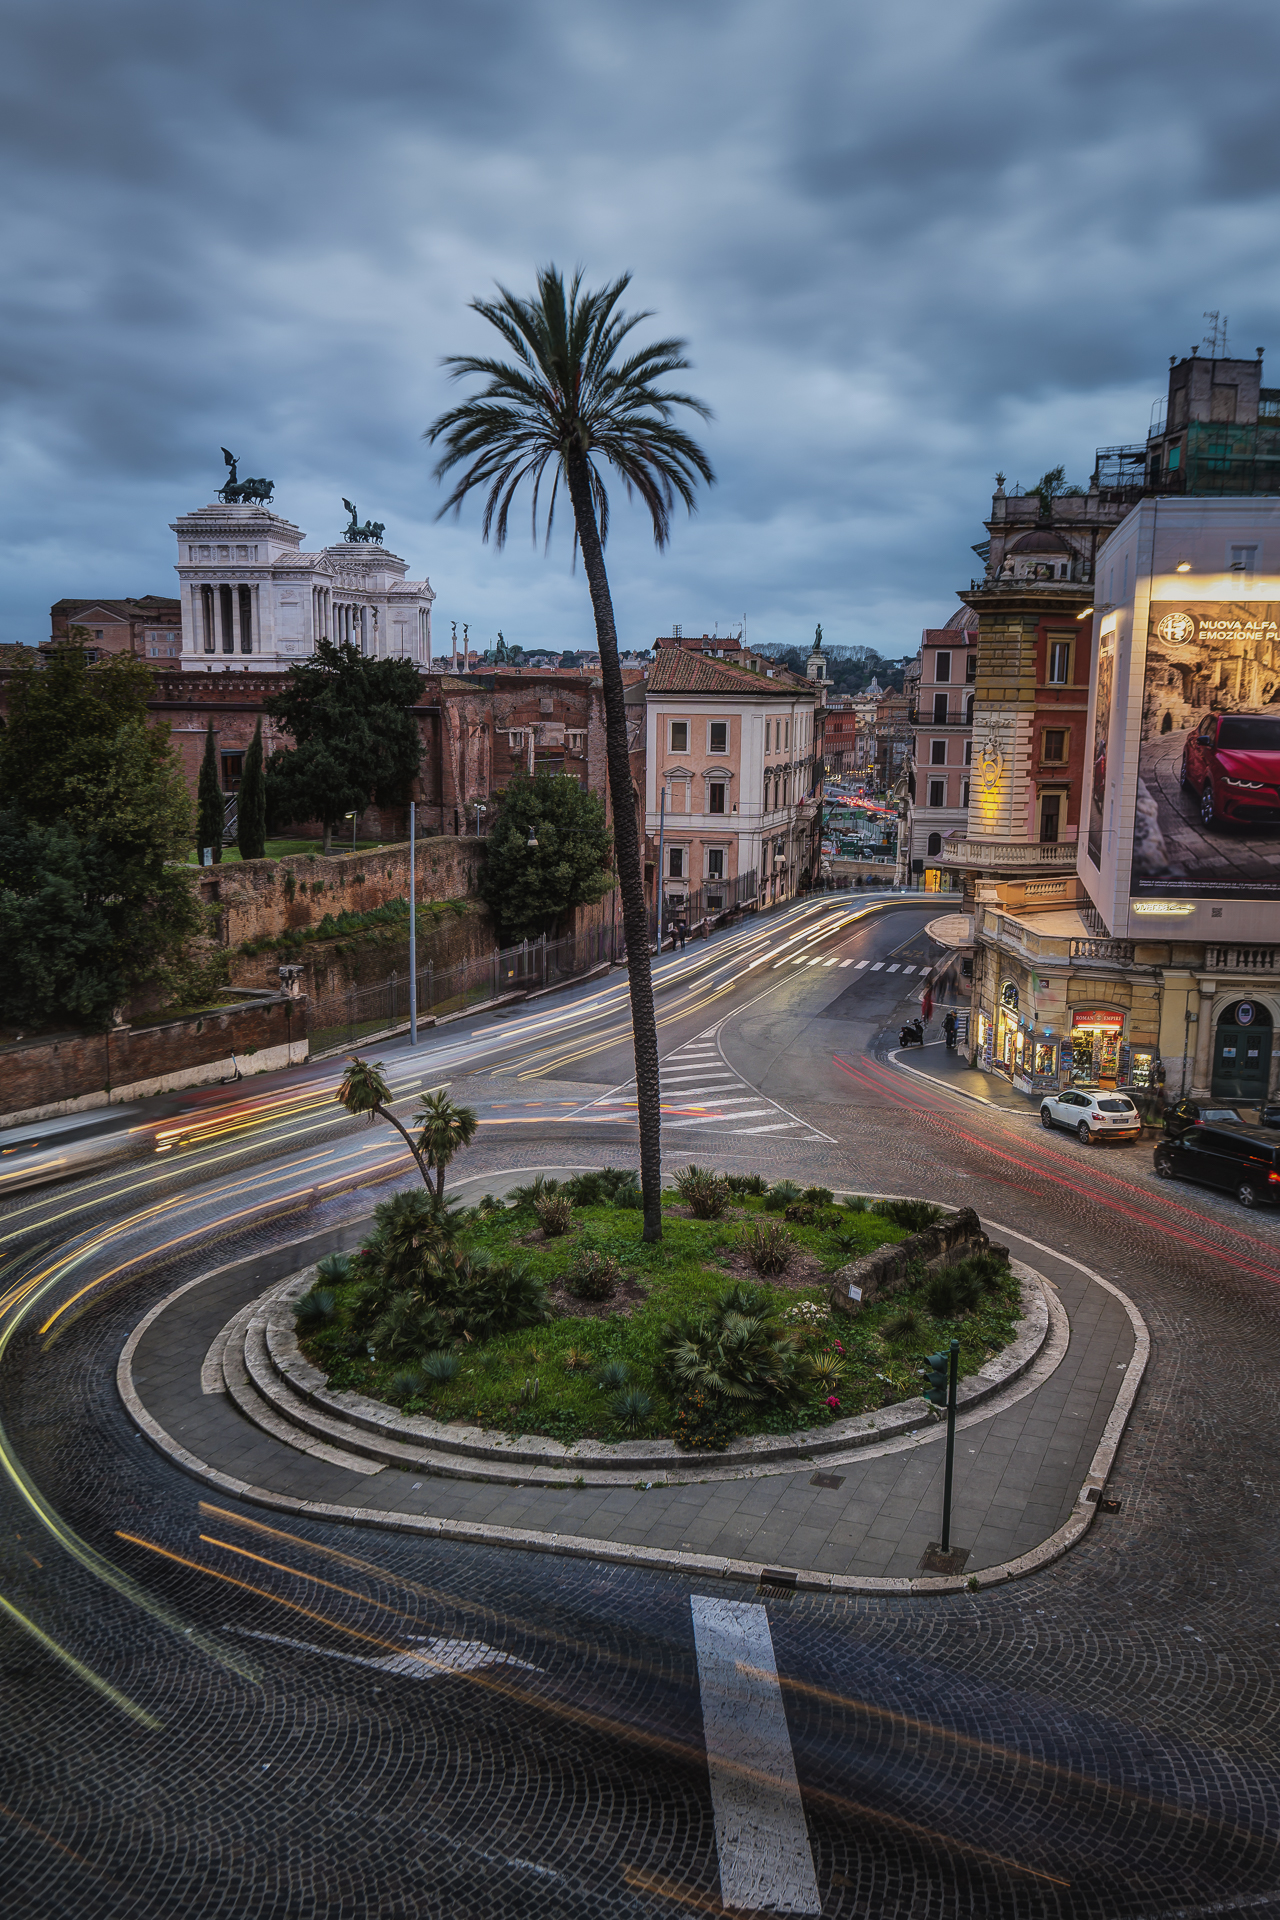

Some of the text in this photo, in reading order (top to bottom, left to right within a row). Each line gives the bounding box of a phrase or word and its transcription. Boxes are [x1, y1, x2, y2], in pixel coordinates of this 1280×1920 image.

[1199, 620, 1278, 630] NUOVA ALFA
[1198, 631, 1263, 640] EMOZIONE
